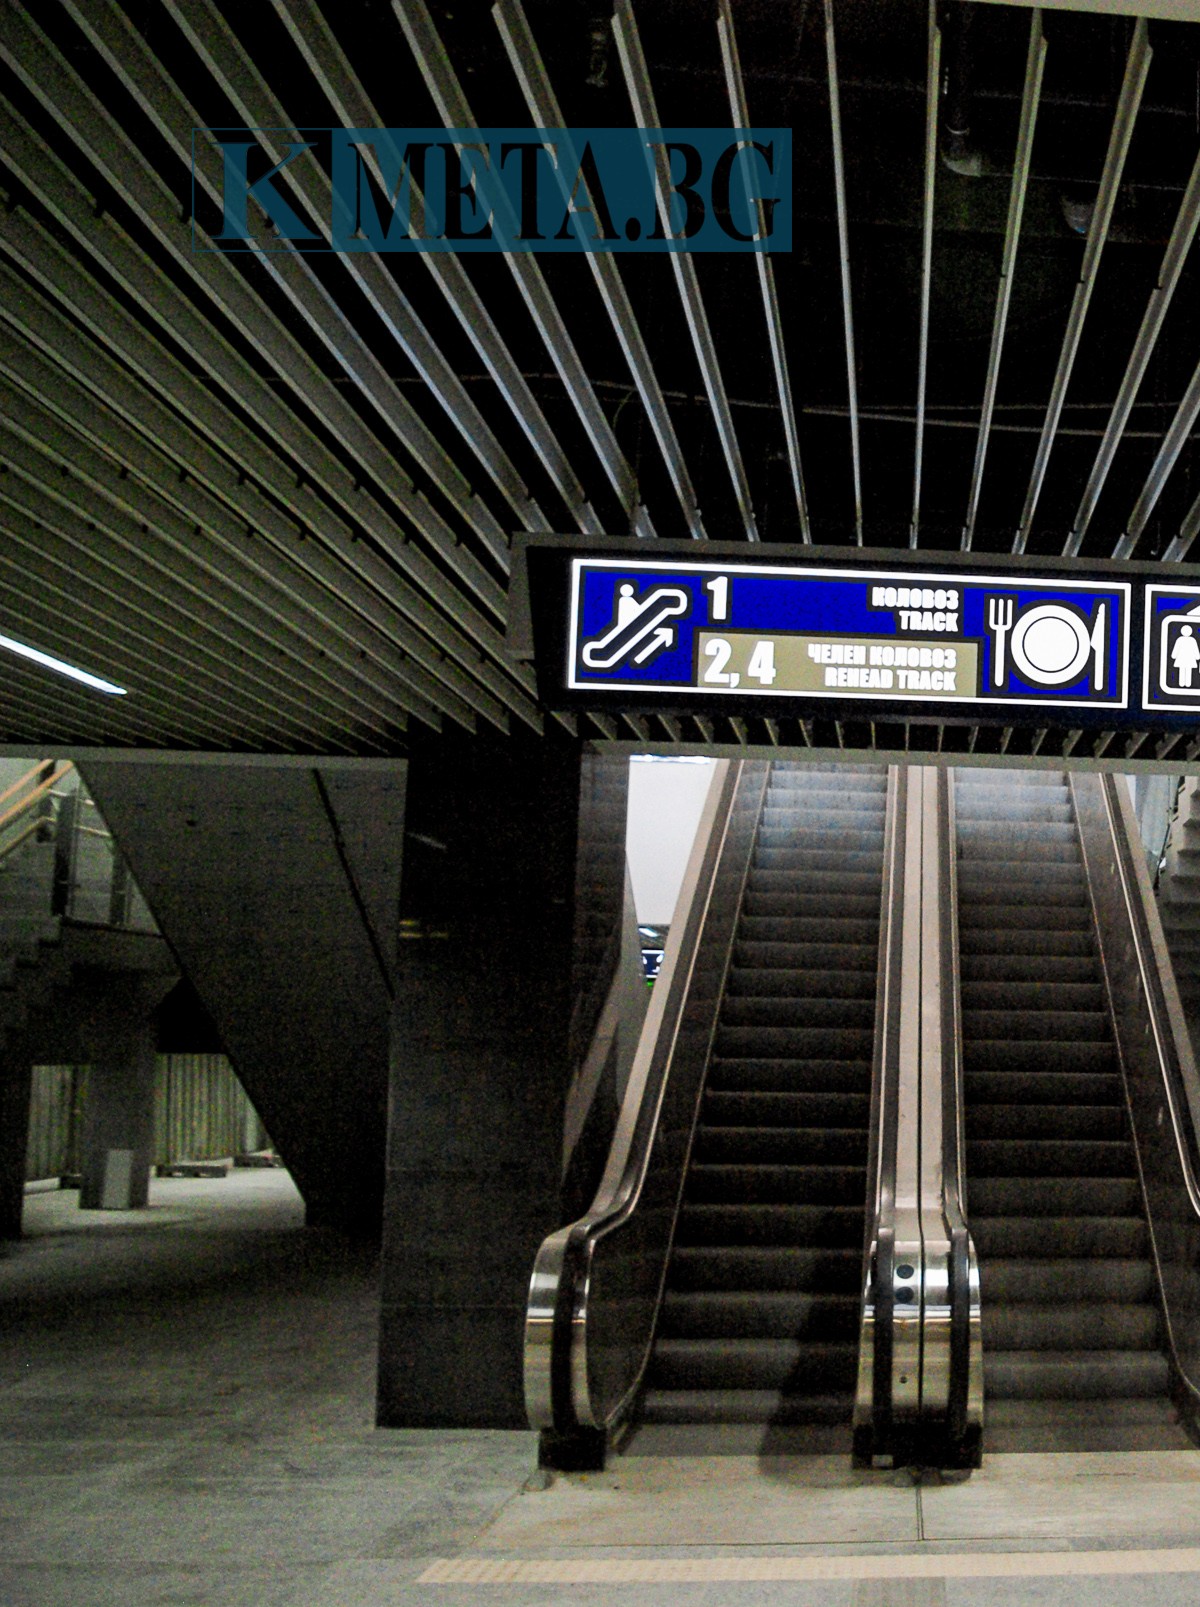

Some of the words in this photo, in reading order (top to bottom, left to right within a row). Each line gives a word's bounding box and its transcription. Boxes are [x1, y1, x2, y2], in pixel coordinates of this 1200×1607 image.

[706, 576, 728, 620] 1
[872, 586, 959, 610] КОЛОВОЗ
[898, 610, 959, 632] TRACK
[869, 645, 957, 669] КОЛОВОЗ
[896, 669, 957, 692] TRACK
